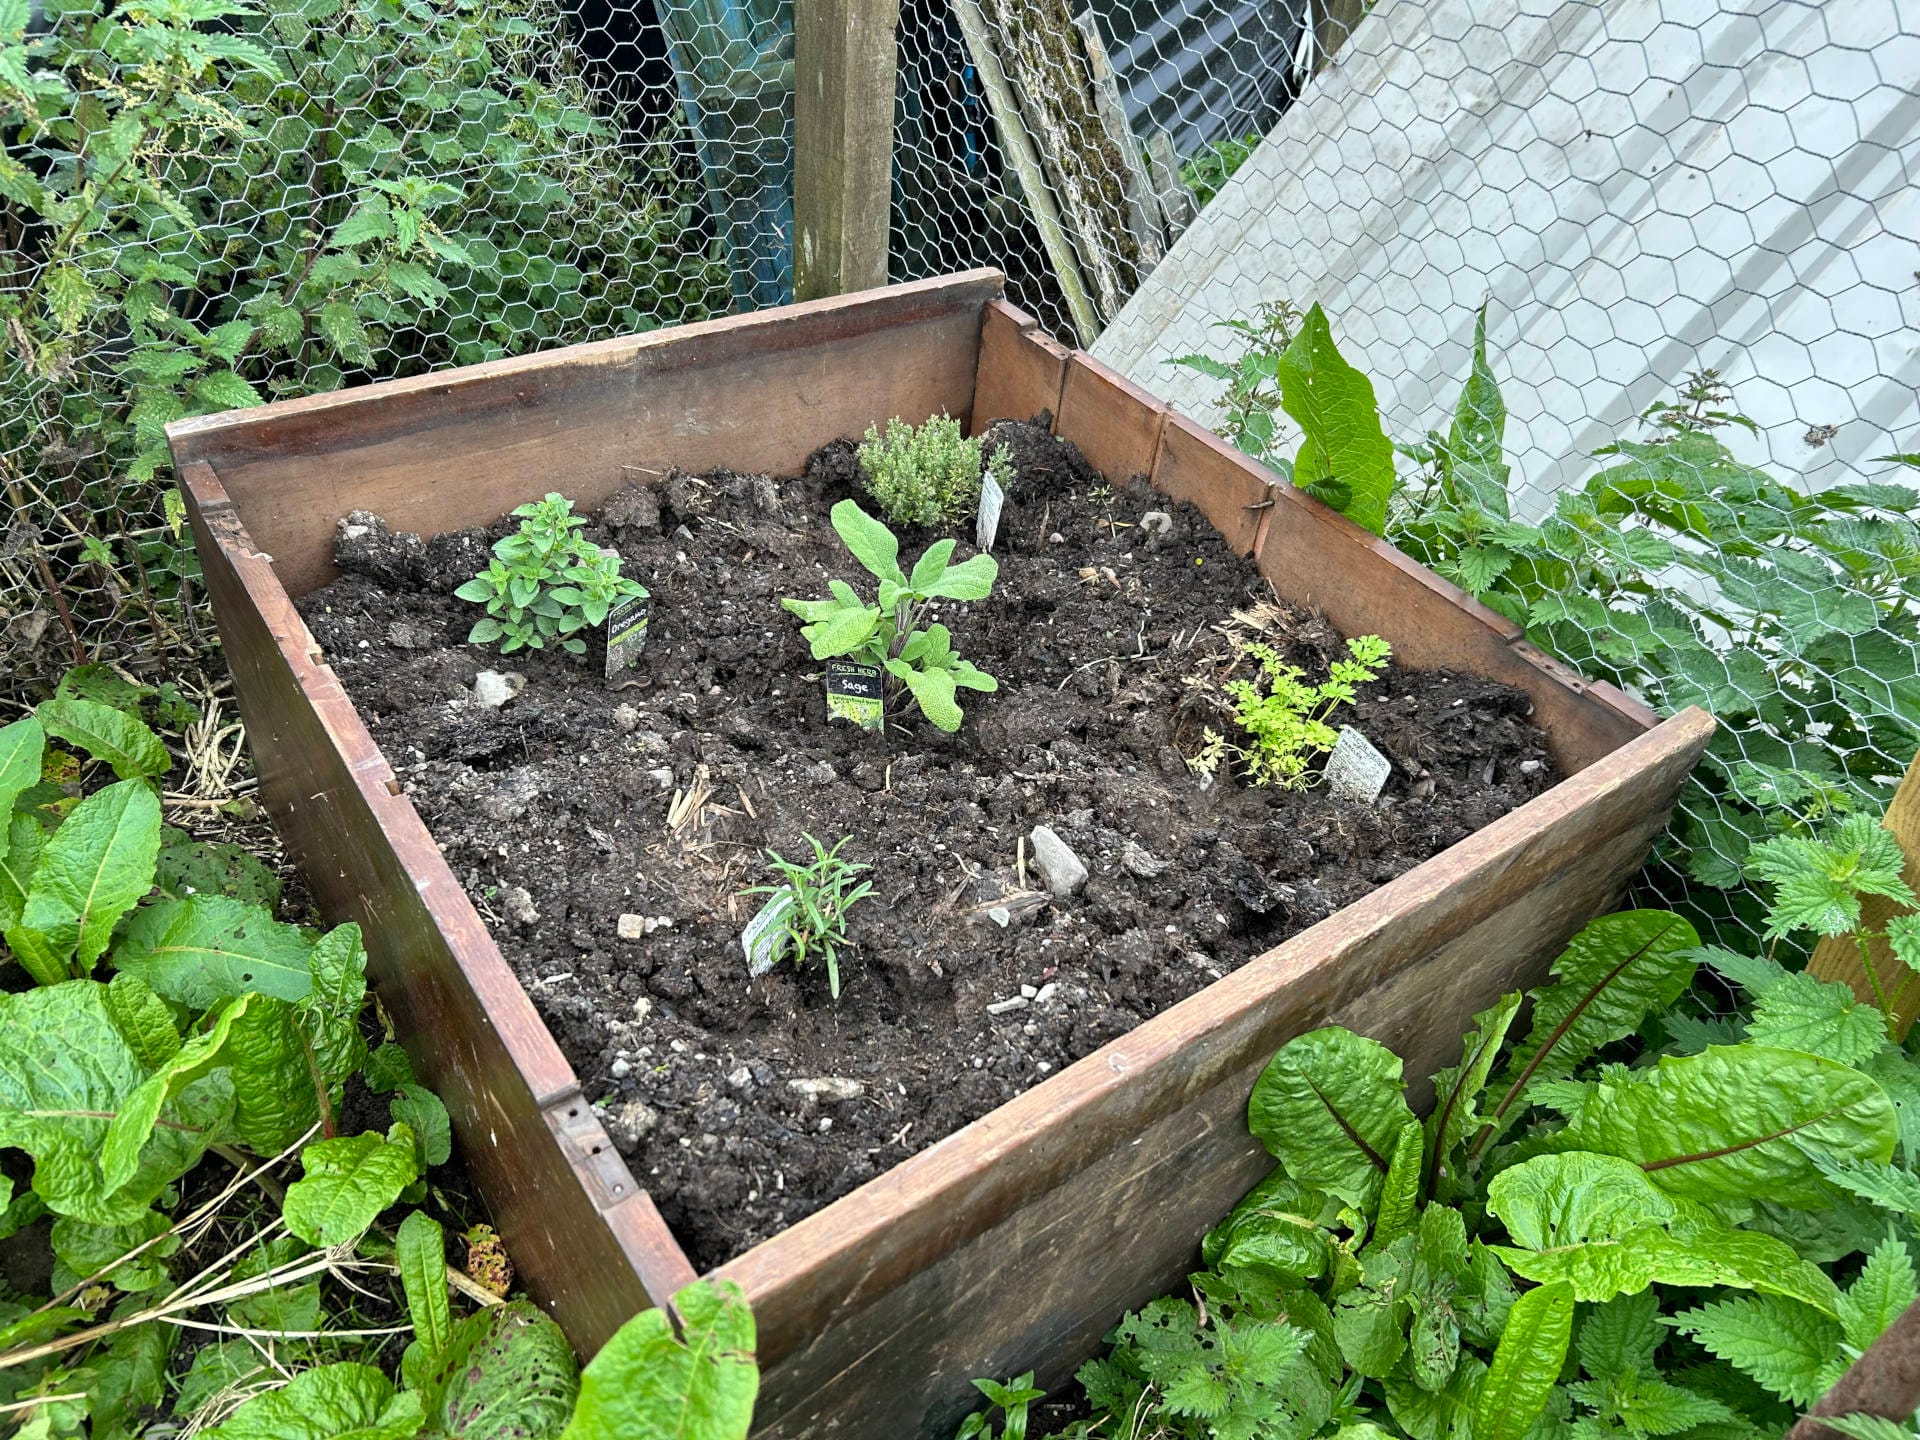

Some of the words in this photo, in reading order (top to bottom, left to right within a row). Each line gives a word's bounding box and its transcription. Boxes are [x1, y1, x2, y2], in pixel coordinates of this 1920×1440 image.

[611, 608, 647, 634] Oregano
[831, 663, 855, 673] FRESH
[857, 667, 877, 677] HERB
[841, 679, 868, 694] Sage
